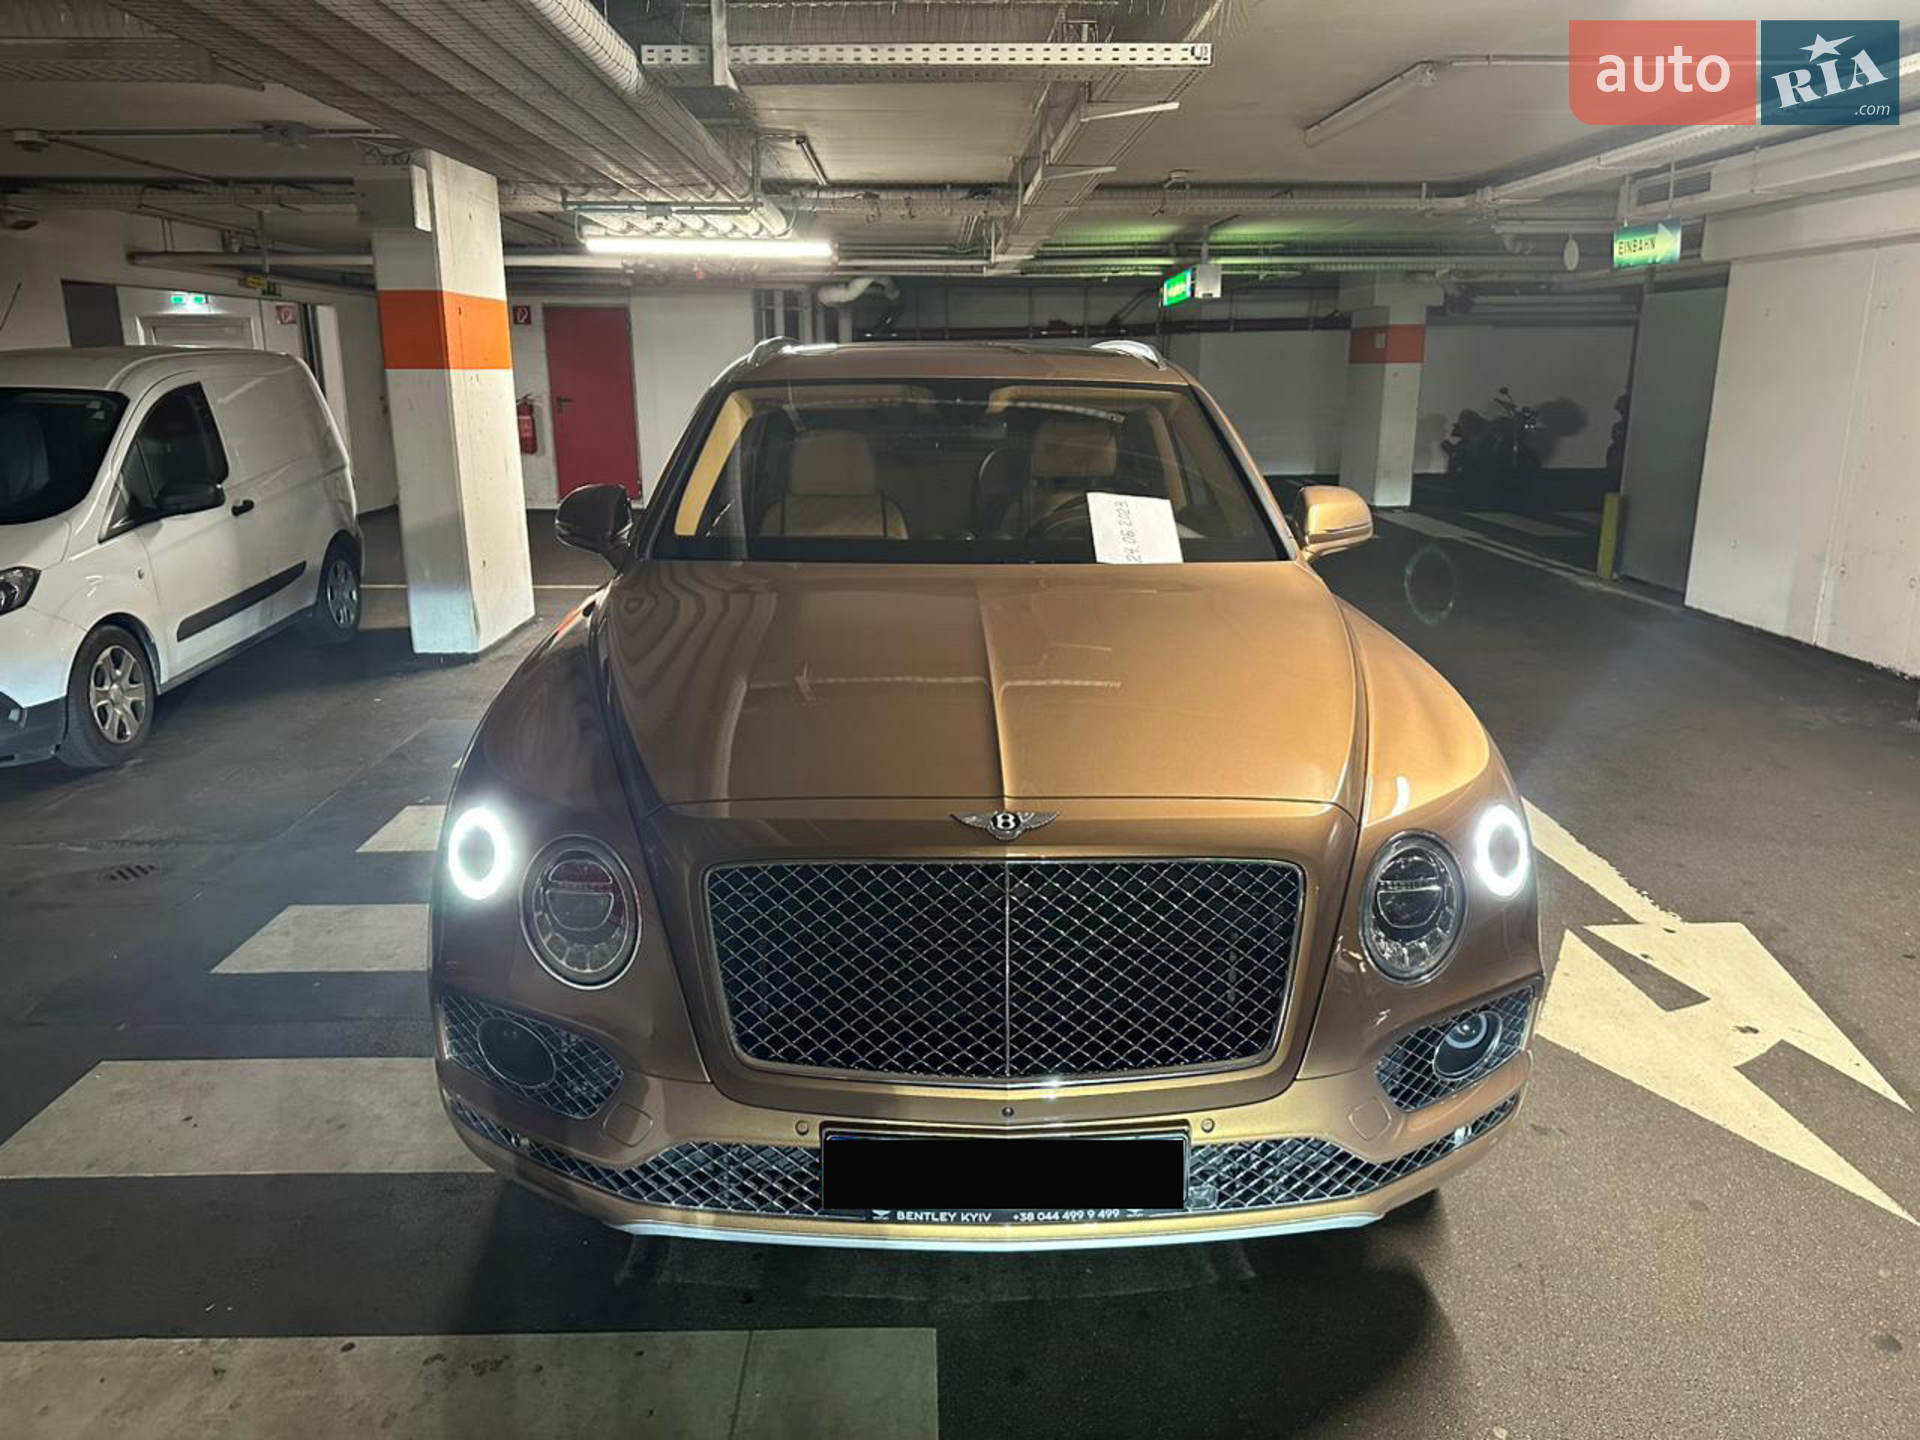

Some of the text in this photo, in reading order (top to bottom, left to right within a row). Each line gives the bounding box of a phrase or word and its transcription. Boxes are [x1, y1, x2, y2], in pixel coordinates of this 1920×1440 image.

[997, 812, 1016, 830] B
[896, 1208, 1120, 1222] BENTLEY KYIV +38 044 499 9 499
